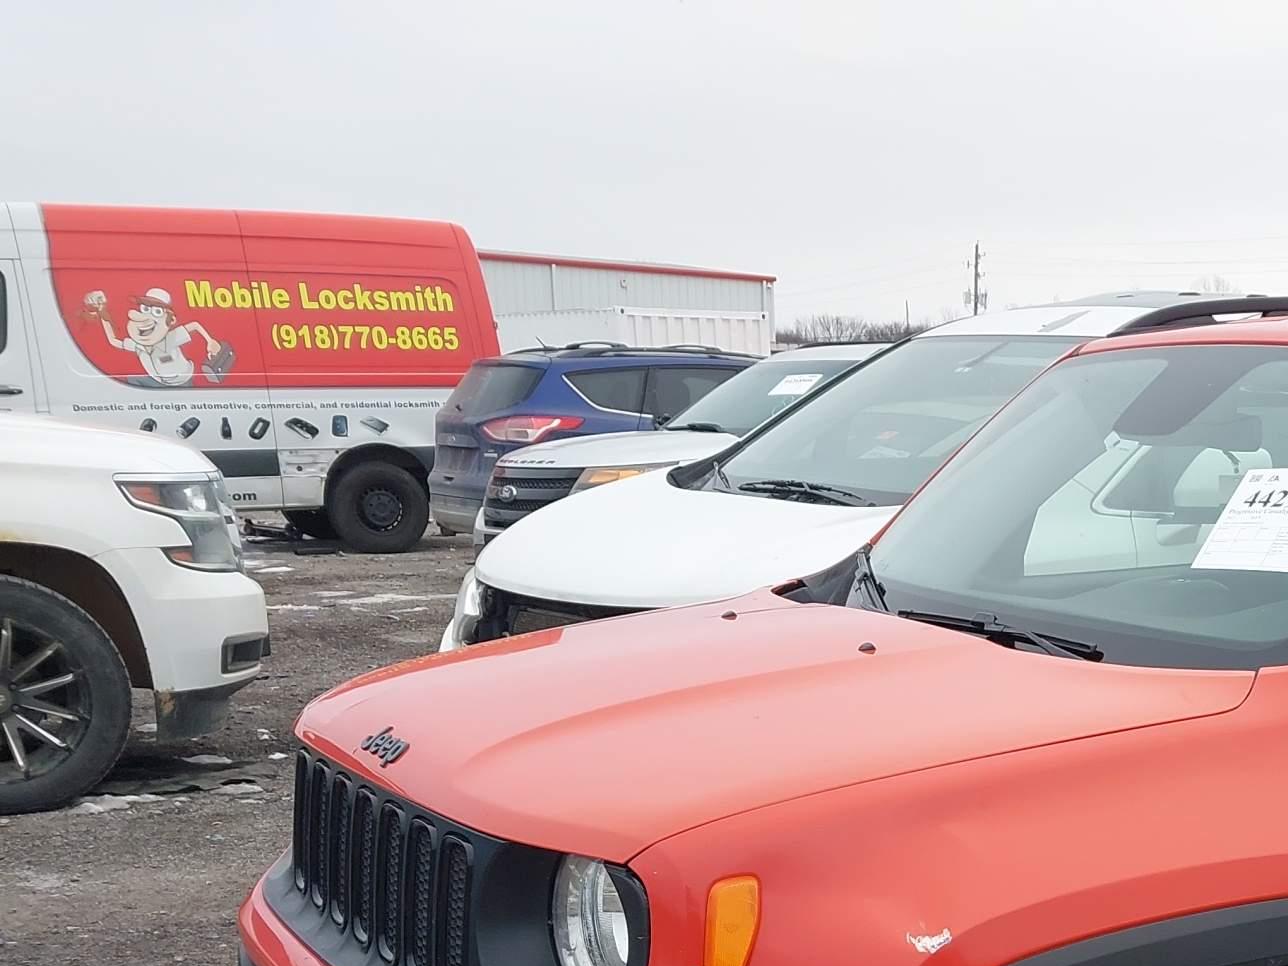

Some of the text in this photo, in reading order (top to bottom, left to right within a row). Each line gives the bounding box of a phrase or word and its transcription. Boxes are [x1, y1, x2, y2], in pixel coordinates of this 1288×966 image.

[185, 280, 454, 312] Mobile Locksmith
[271, 324, 459, 350] (918)770-8665
[72, 403, 124, 412] Domestic
[127, 403, 147, 411] and
[150, 402, 187, 412] foreign
[190, 402, 252, 411] automotive,
[254, 401, 317, 410] commercial,
[319, 401, 338, 409] and
[340, 401, 392, 409] residential
[394, 400, 440, 409] locksmith
[361, 726, 410, 768] Jeep
